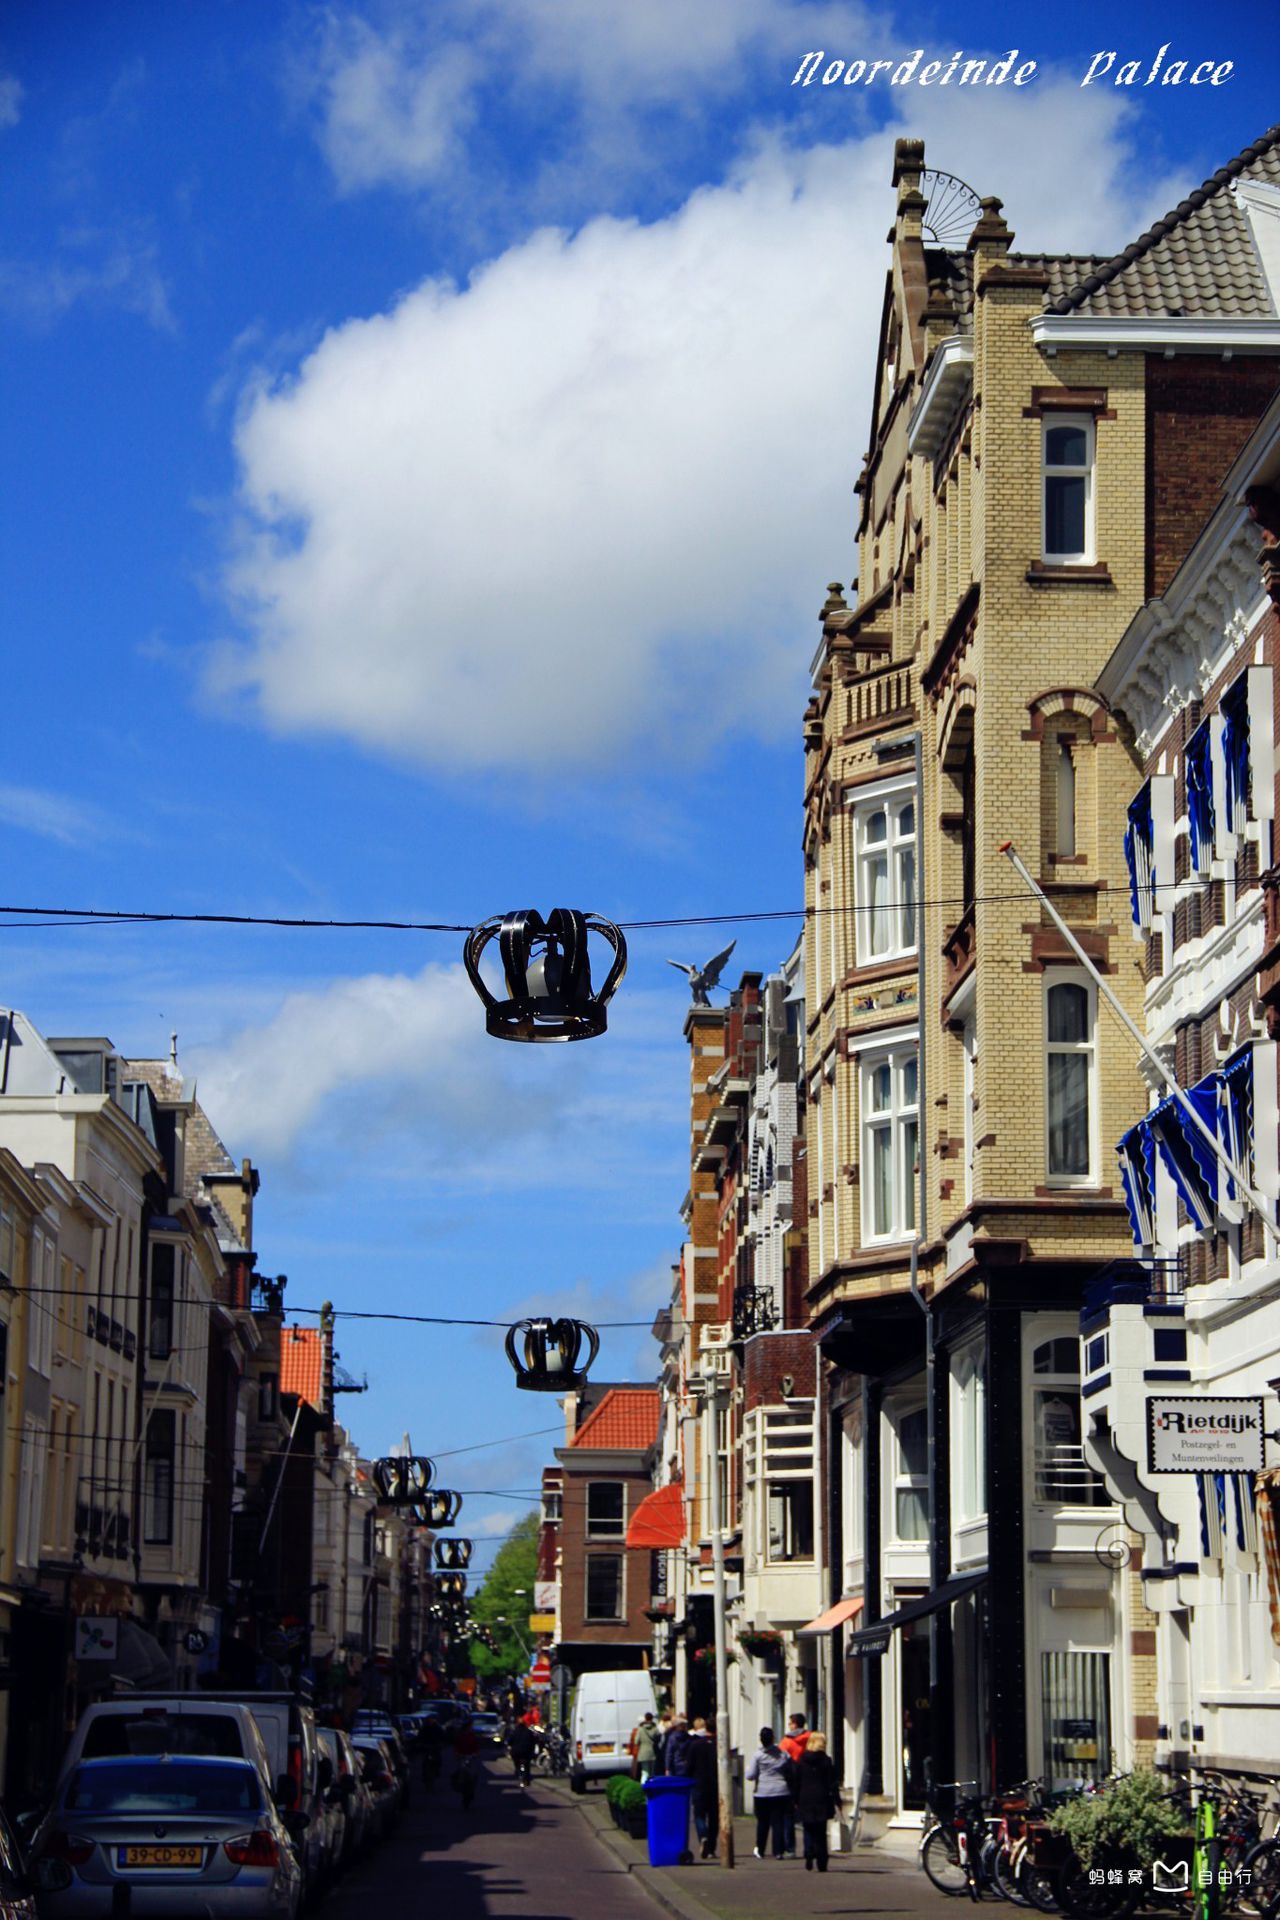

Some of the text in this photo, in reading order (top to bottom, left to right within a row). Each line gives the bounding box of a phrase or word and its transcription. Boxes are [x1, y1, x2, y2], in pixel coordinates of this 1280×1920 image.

[1162, 1412, 1257, 1434] Rietdijk
[1181, 1440, 1222, 1451] Postzegel-
[1172, 1453, 1244, 1464] Muntenveilingen
[129, 1848, 197, 1863] 39-CD-99
